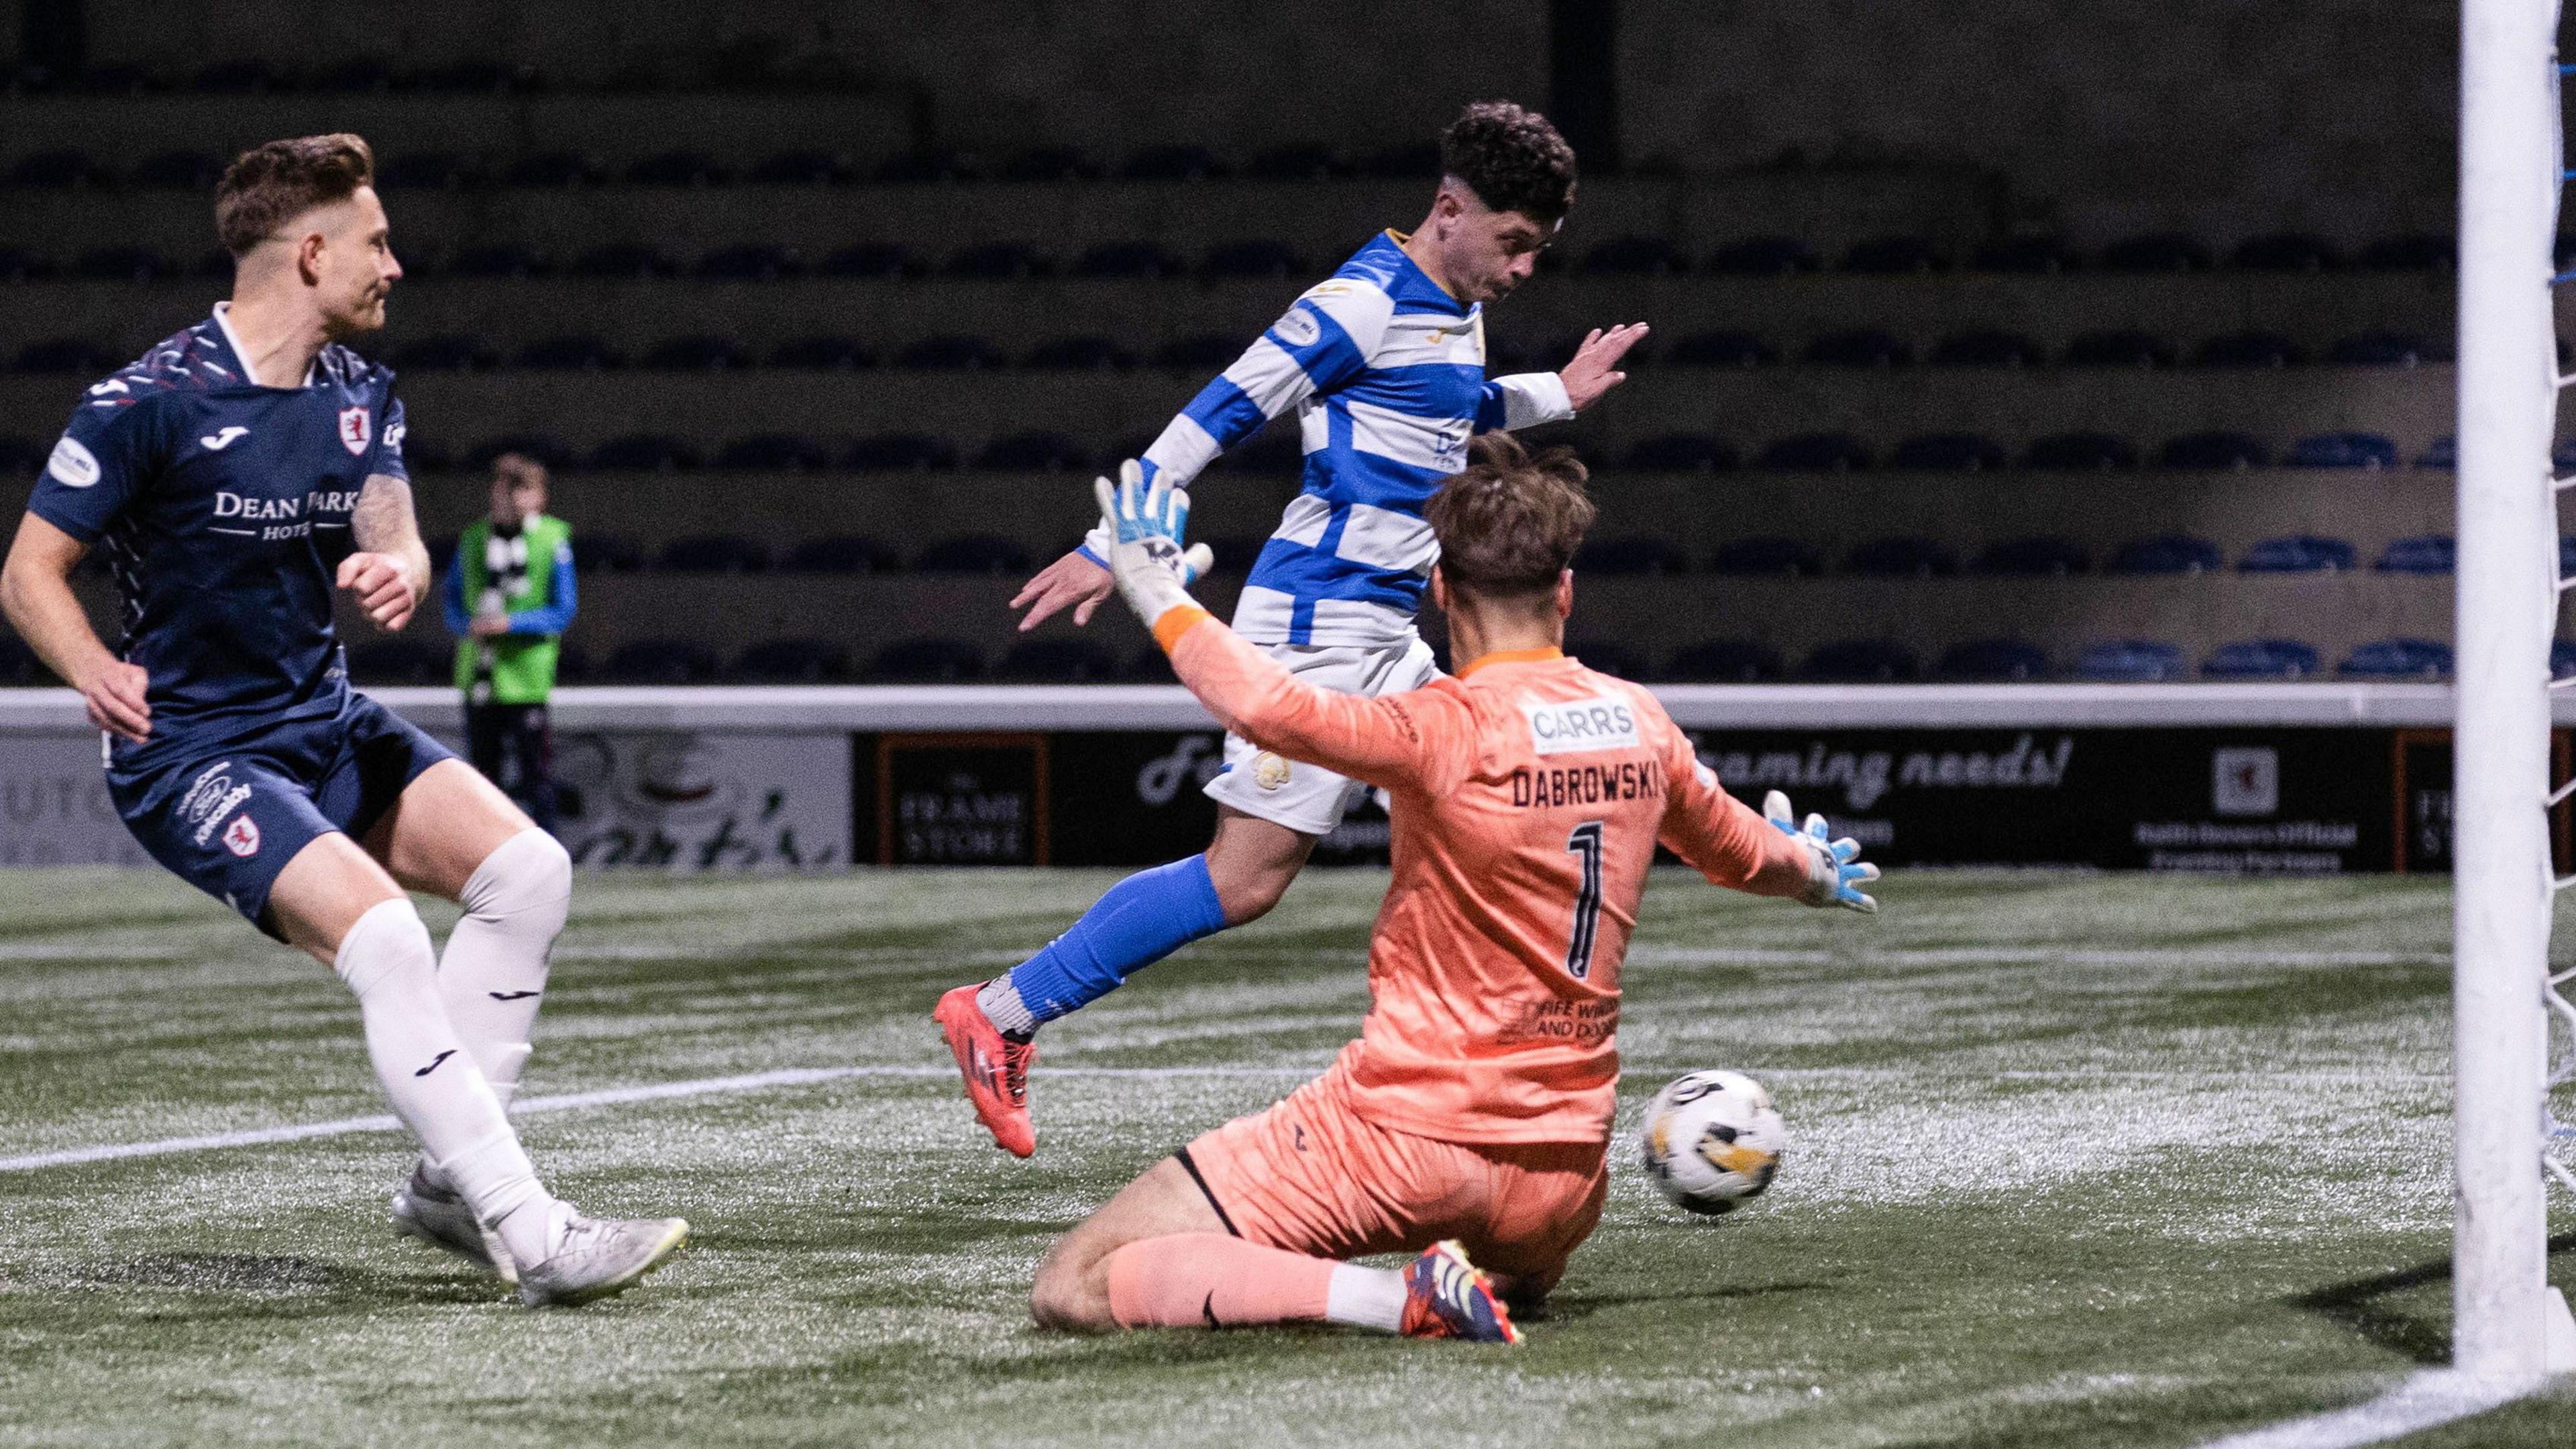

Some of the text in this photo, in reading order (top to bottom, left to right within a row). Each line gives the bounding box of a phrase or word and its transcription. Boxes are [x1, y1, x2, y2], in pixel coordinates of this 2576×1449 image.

[212, 491, 301, 519] DEAN
[1534, 705, 1634, 739] CARRS
[1897, 735, 2074, 787] needs!
[1513, 760, 1659, 808] DABROWSKI
[1566, 820, 1604, 983] 1
[1537, 1020, 1573, 1036] AND
